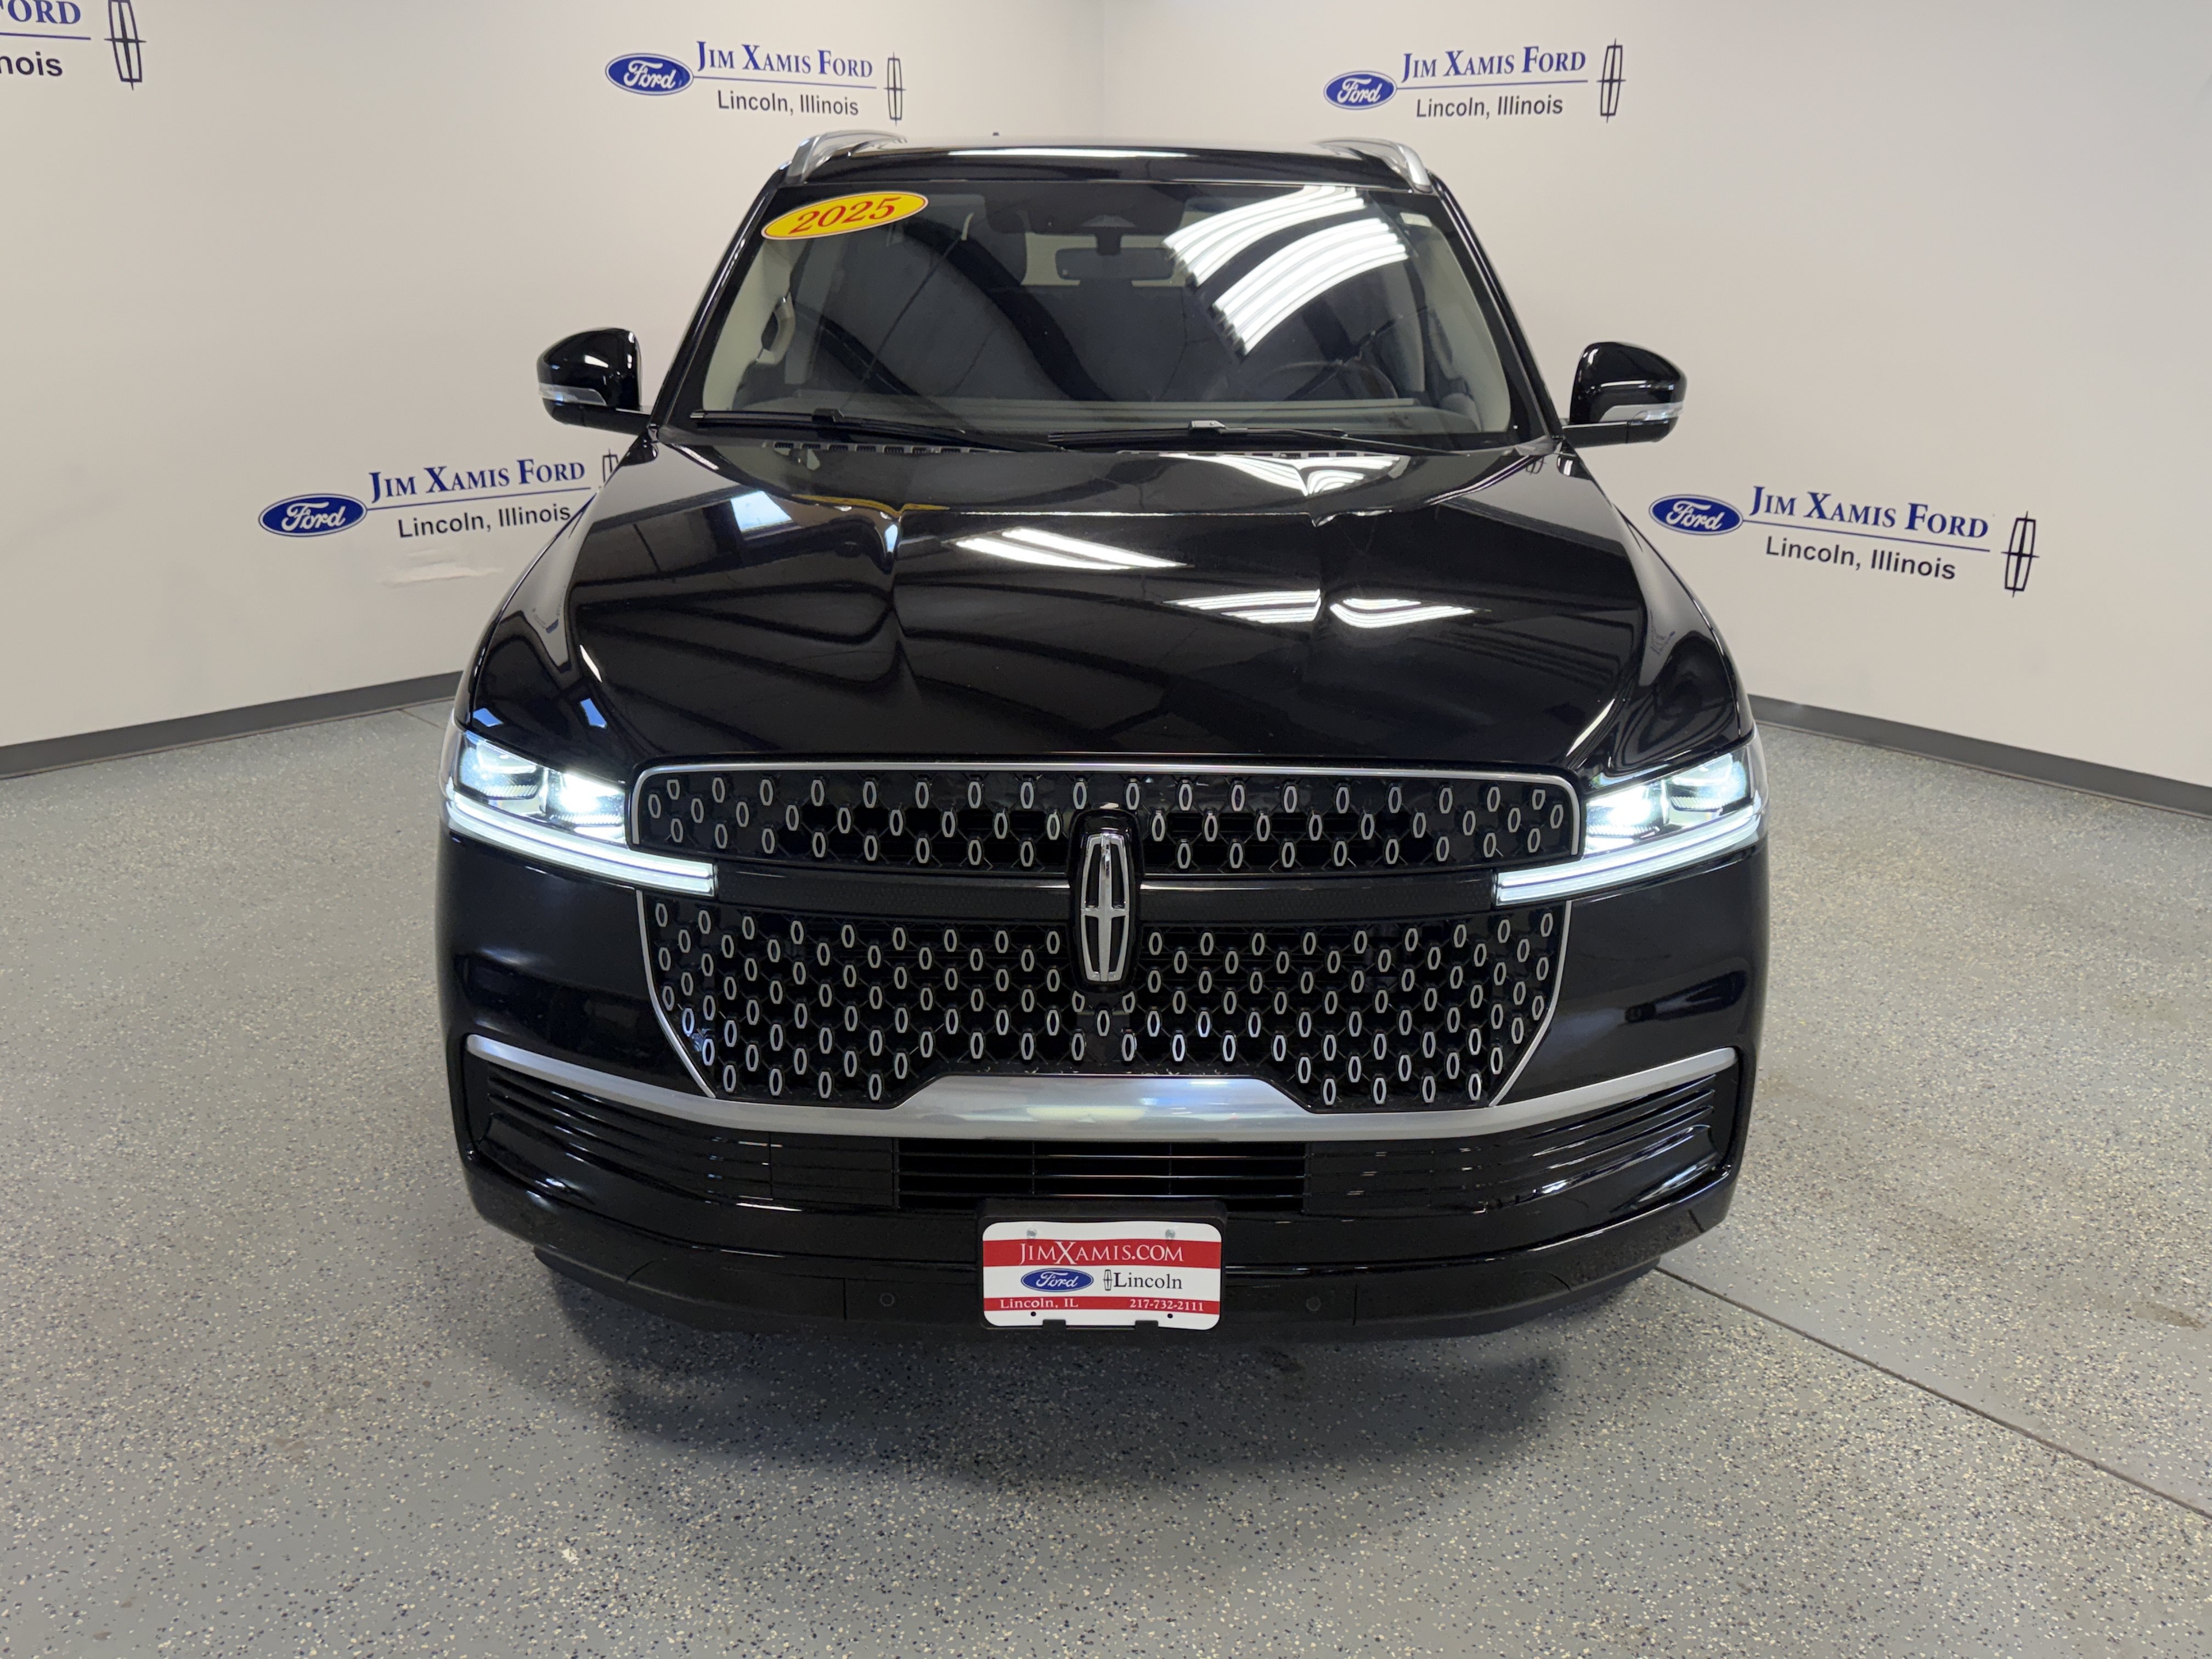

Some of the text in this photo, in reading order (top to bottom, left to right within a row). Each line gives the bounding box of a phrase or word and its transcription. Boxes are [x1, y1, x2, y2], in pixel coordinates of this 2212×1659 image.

[0, 0, 81, 24] ORD
[623, 60, 676, 89] Ford
[696, 41, 873, 78] JIM XAMIS FORD
[1401, 46, 1586, 83] JIM XAMIS FORD
[718, 90, 859, 116] Lincoln, Illinois
[1336, 78, 1381, 103] Ford
[1417, 94, 1563, 120] Lincoln, Illinois
[788, 197, 901, 234] 2025
[368, 459, 585, 504] JIM XAMIS FORD
[280, 501, 346, 532] Ford
[397, 503, 571, 538] Lincoln, Illinois
[1666, 500, 1724, 531] Ford
[1749, 486, 1989, 539] JIM XAMIS FORD
[1766, 535, 1956, 580] Lincoln, Illinois
[1036, 1271, 1079, 1288] Ford
[1114, 1272, 1183, 1290] Lincoln
[1000, 1298, 1079, 1309] Lincoln, IL
[1130, 1299, 1204, 1312] 217-732-2111
